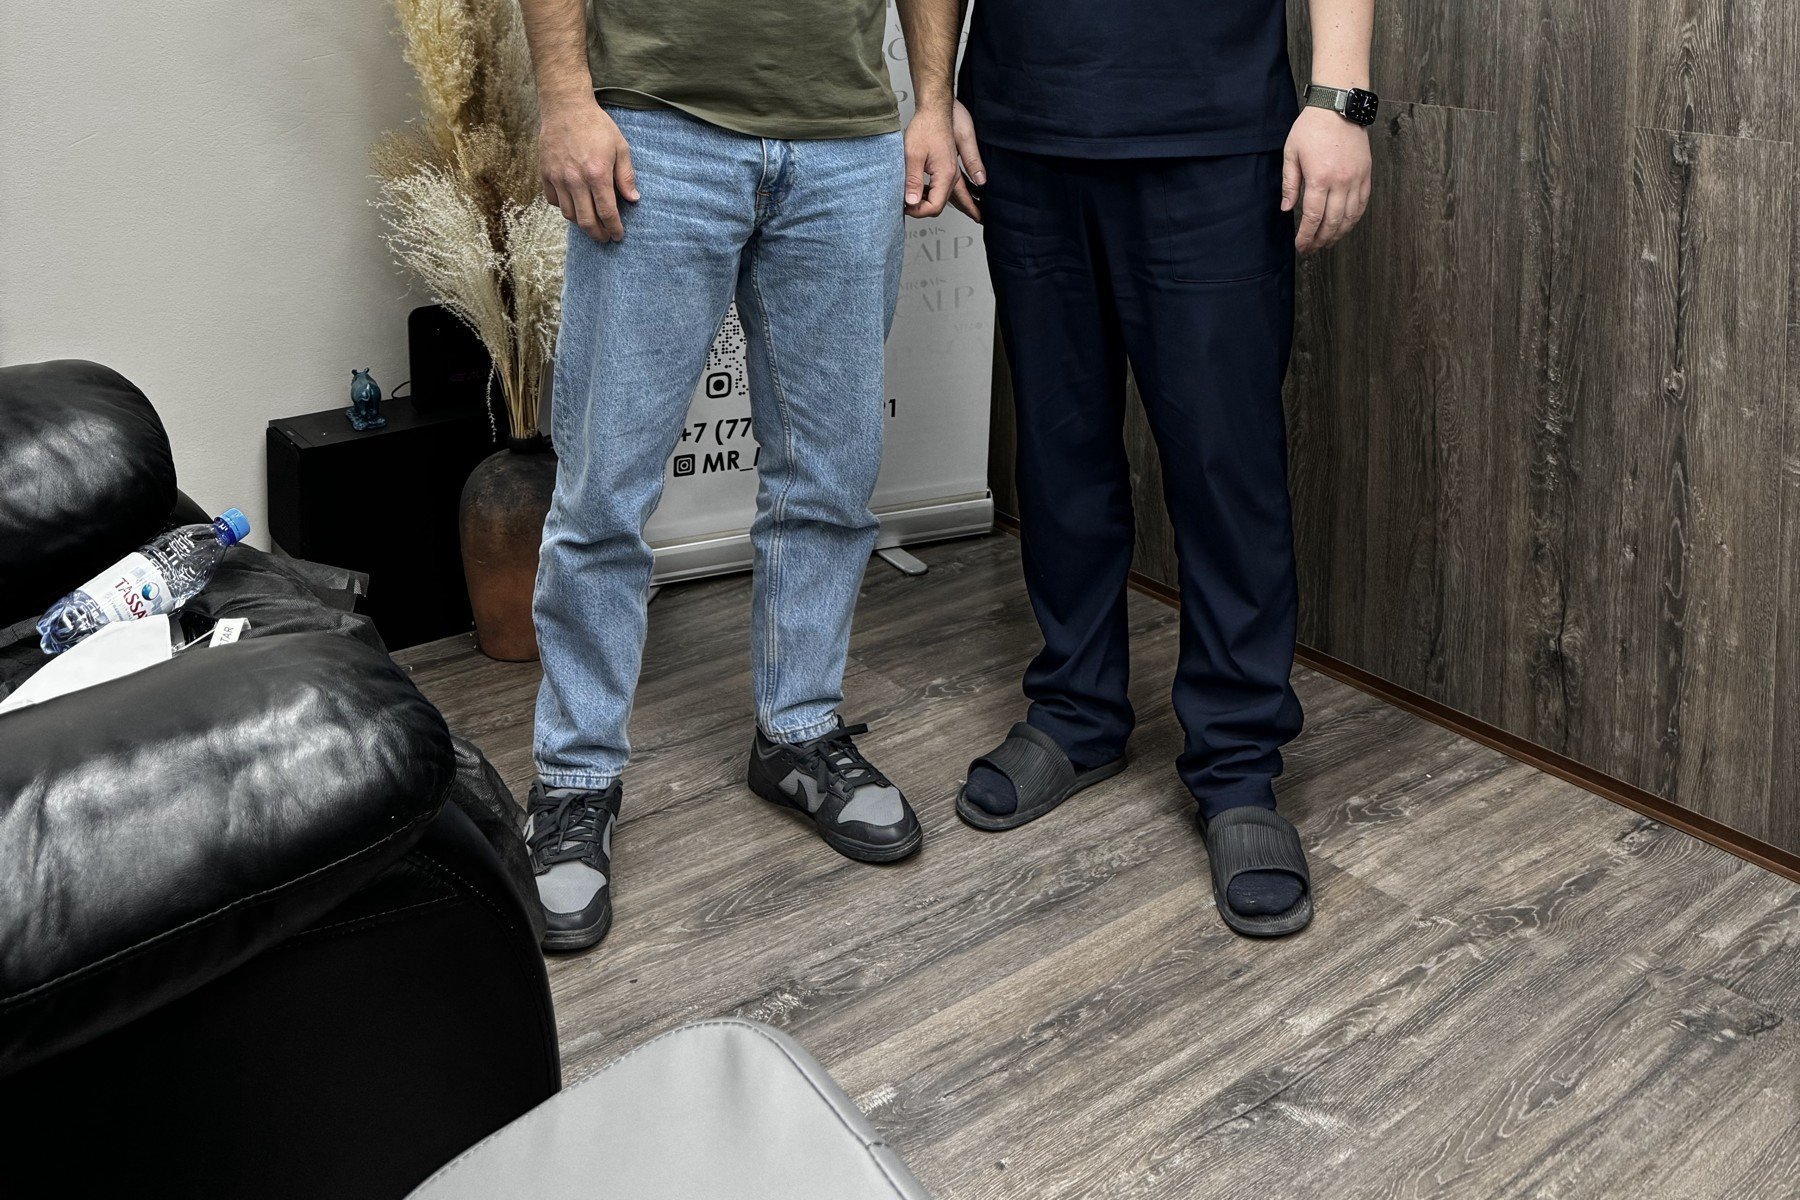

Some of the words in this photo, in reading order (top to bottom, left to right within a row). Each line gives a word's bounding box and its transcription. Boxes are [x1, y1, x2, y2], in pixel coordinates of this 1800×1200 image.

[681, 422, 707, 443] +7
[715, 417, 752, 445] (77
[702, 447, 760, 474] MR_
[114, 577, 150, 619] TASSA
[218, 625, 234, 647] TAR
